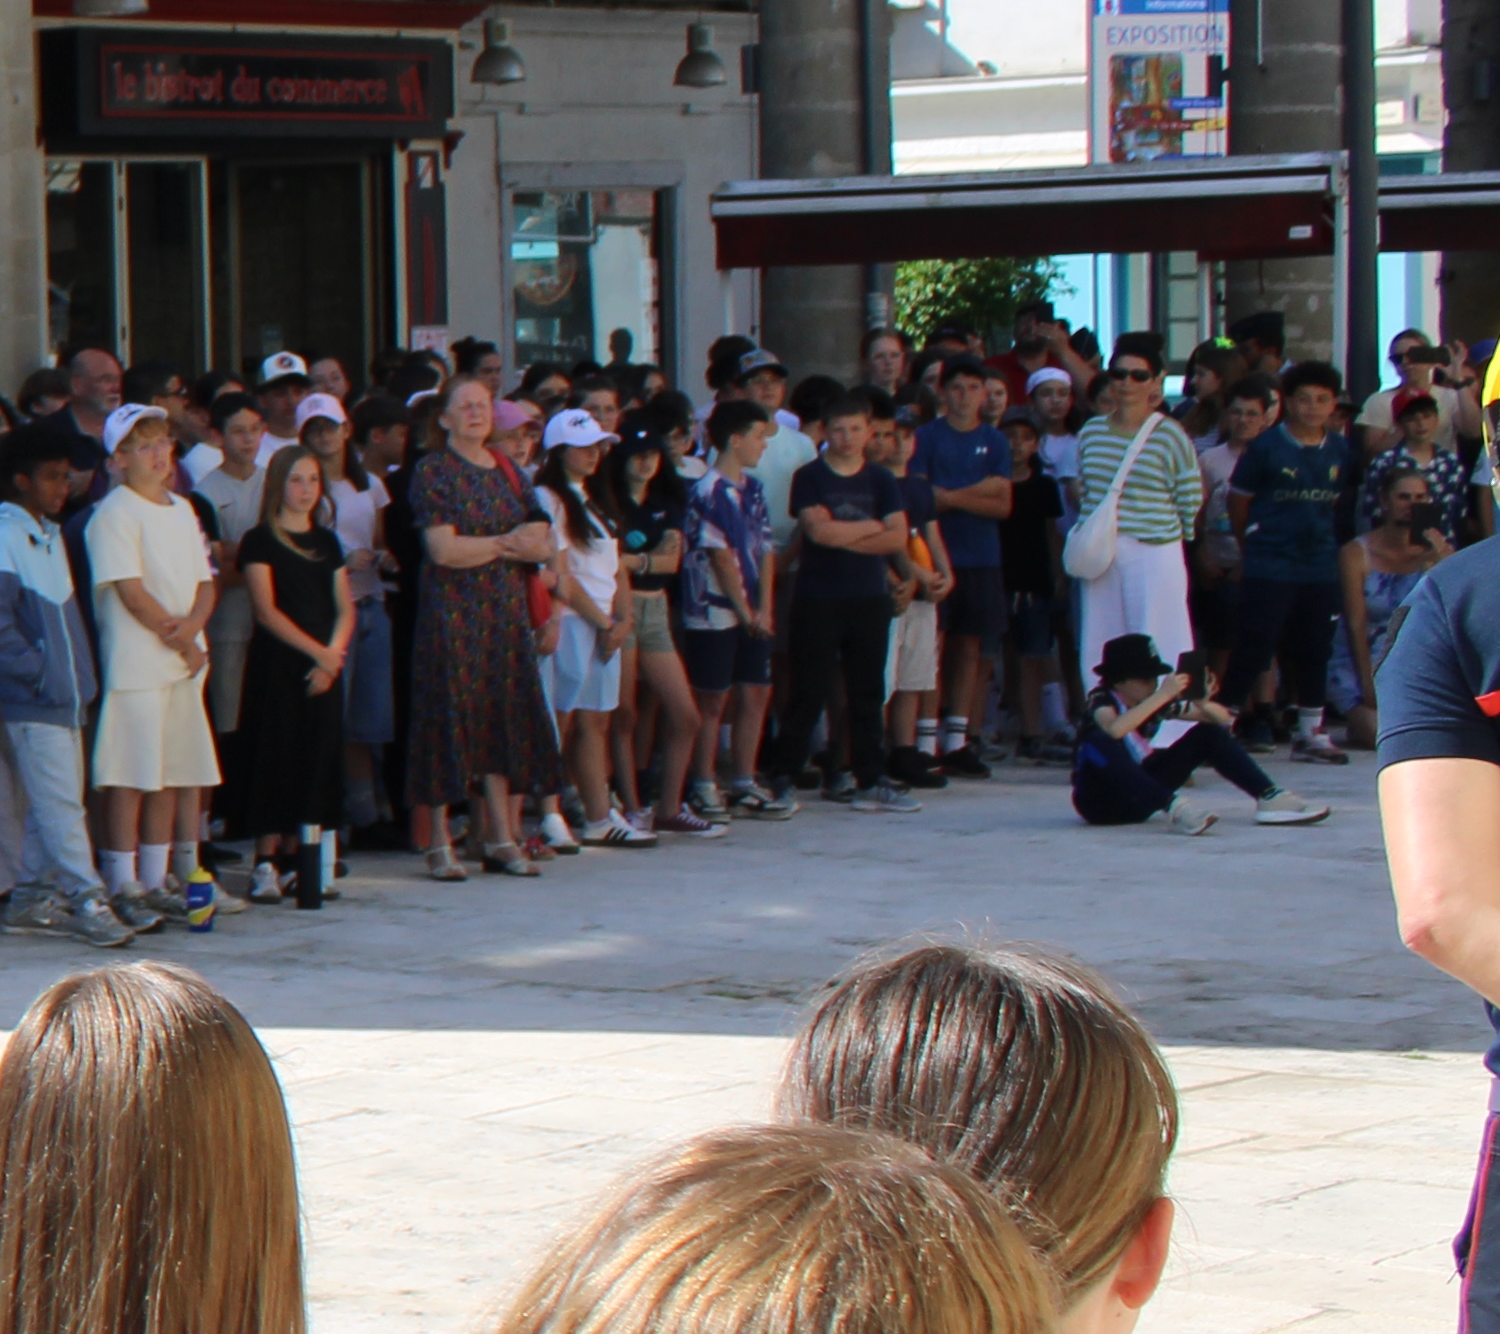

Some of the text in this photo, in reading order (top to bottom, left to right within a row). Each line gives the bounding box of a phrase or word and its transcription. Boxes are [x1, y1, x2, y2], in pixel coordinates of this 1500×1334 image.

[1106, 23, 1224, 46] EXPOSITION
[144, 61, 225, 104] bistrot
[230, 64, 262, 104] du
[267, 75, 389, 104] commerce
